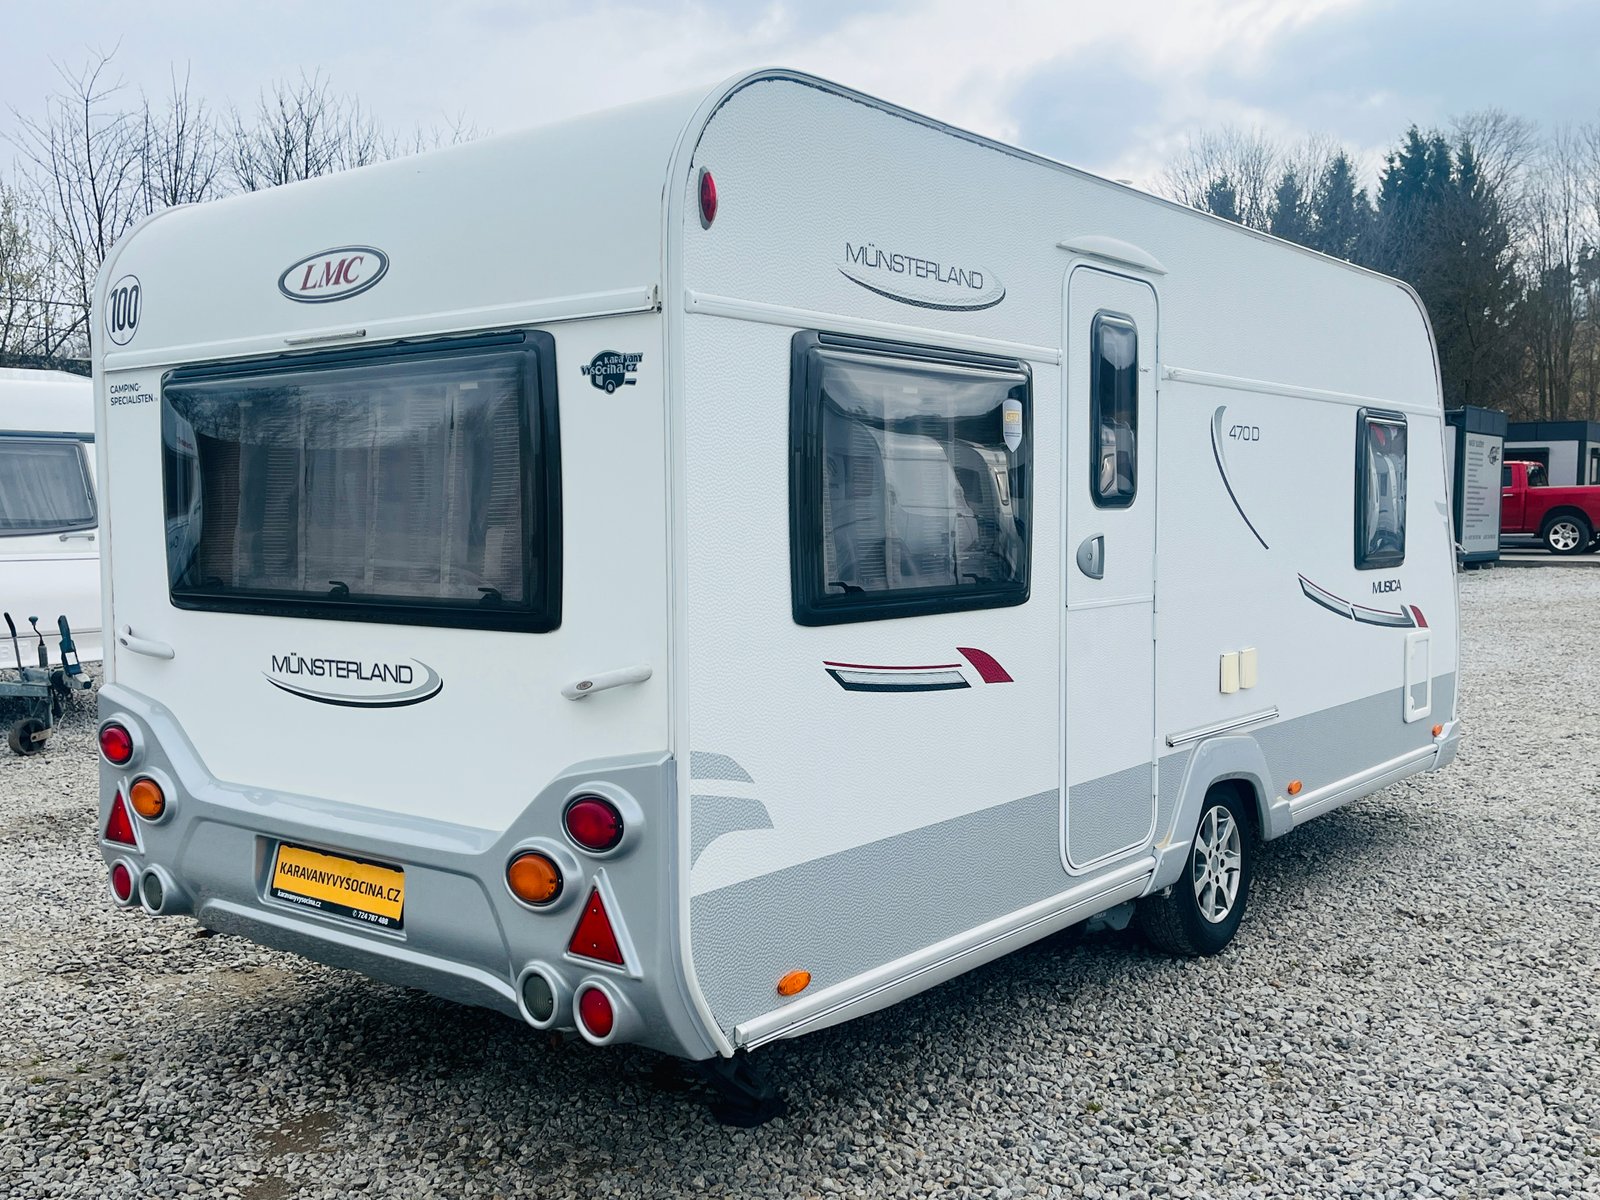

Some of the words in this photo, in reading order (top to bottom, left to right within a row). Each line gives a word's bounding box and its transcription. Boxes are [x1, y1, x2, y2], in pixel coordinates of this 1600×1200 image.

[300, 255, 364, 291] LMC
[846, 242, 984, 290] MÜNSTERLAND
[111, 284, 139, 333] 100
[1372, 579, 1402, 594] MUSICA
[272, 652, 413, 684] MÜNSTERLAND
[280, 861, 401, 903] KARAVANYVYSOCINA.CZ
